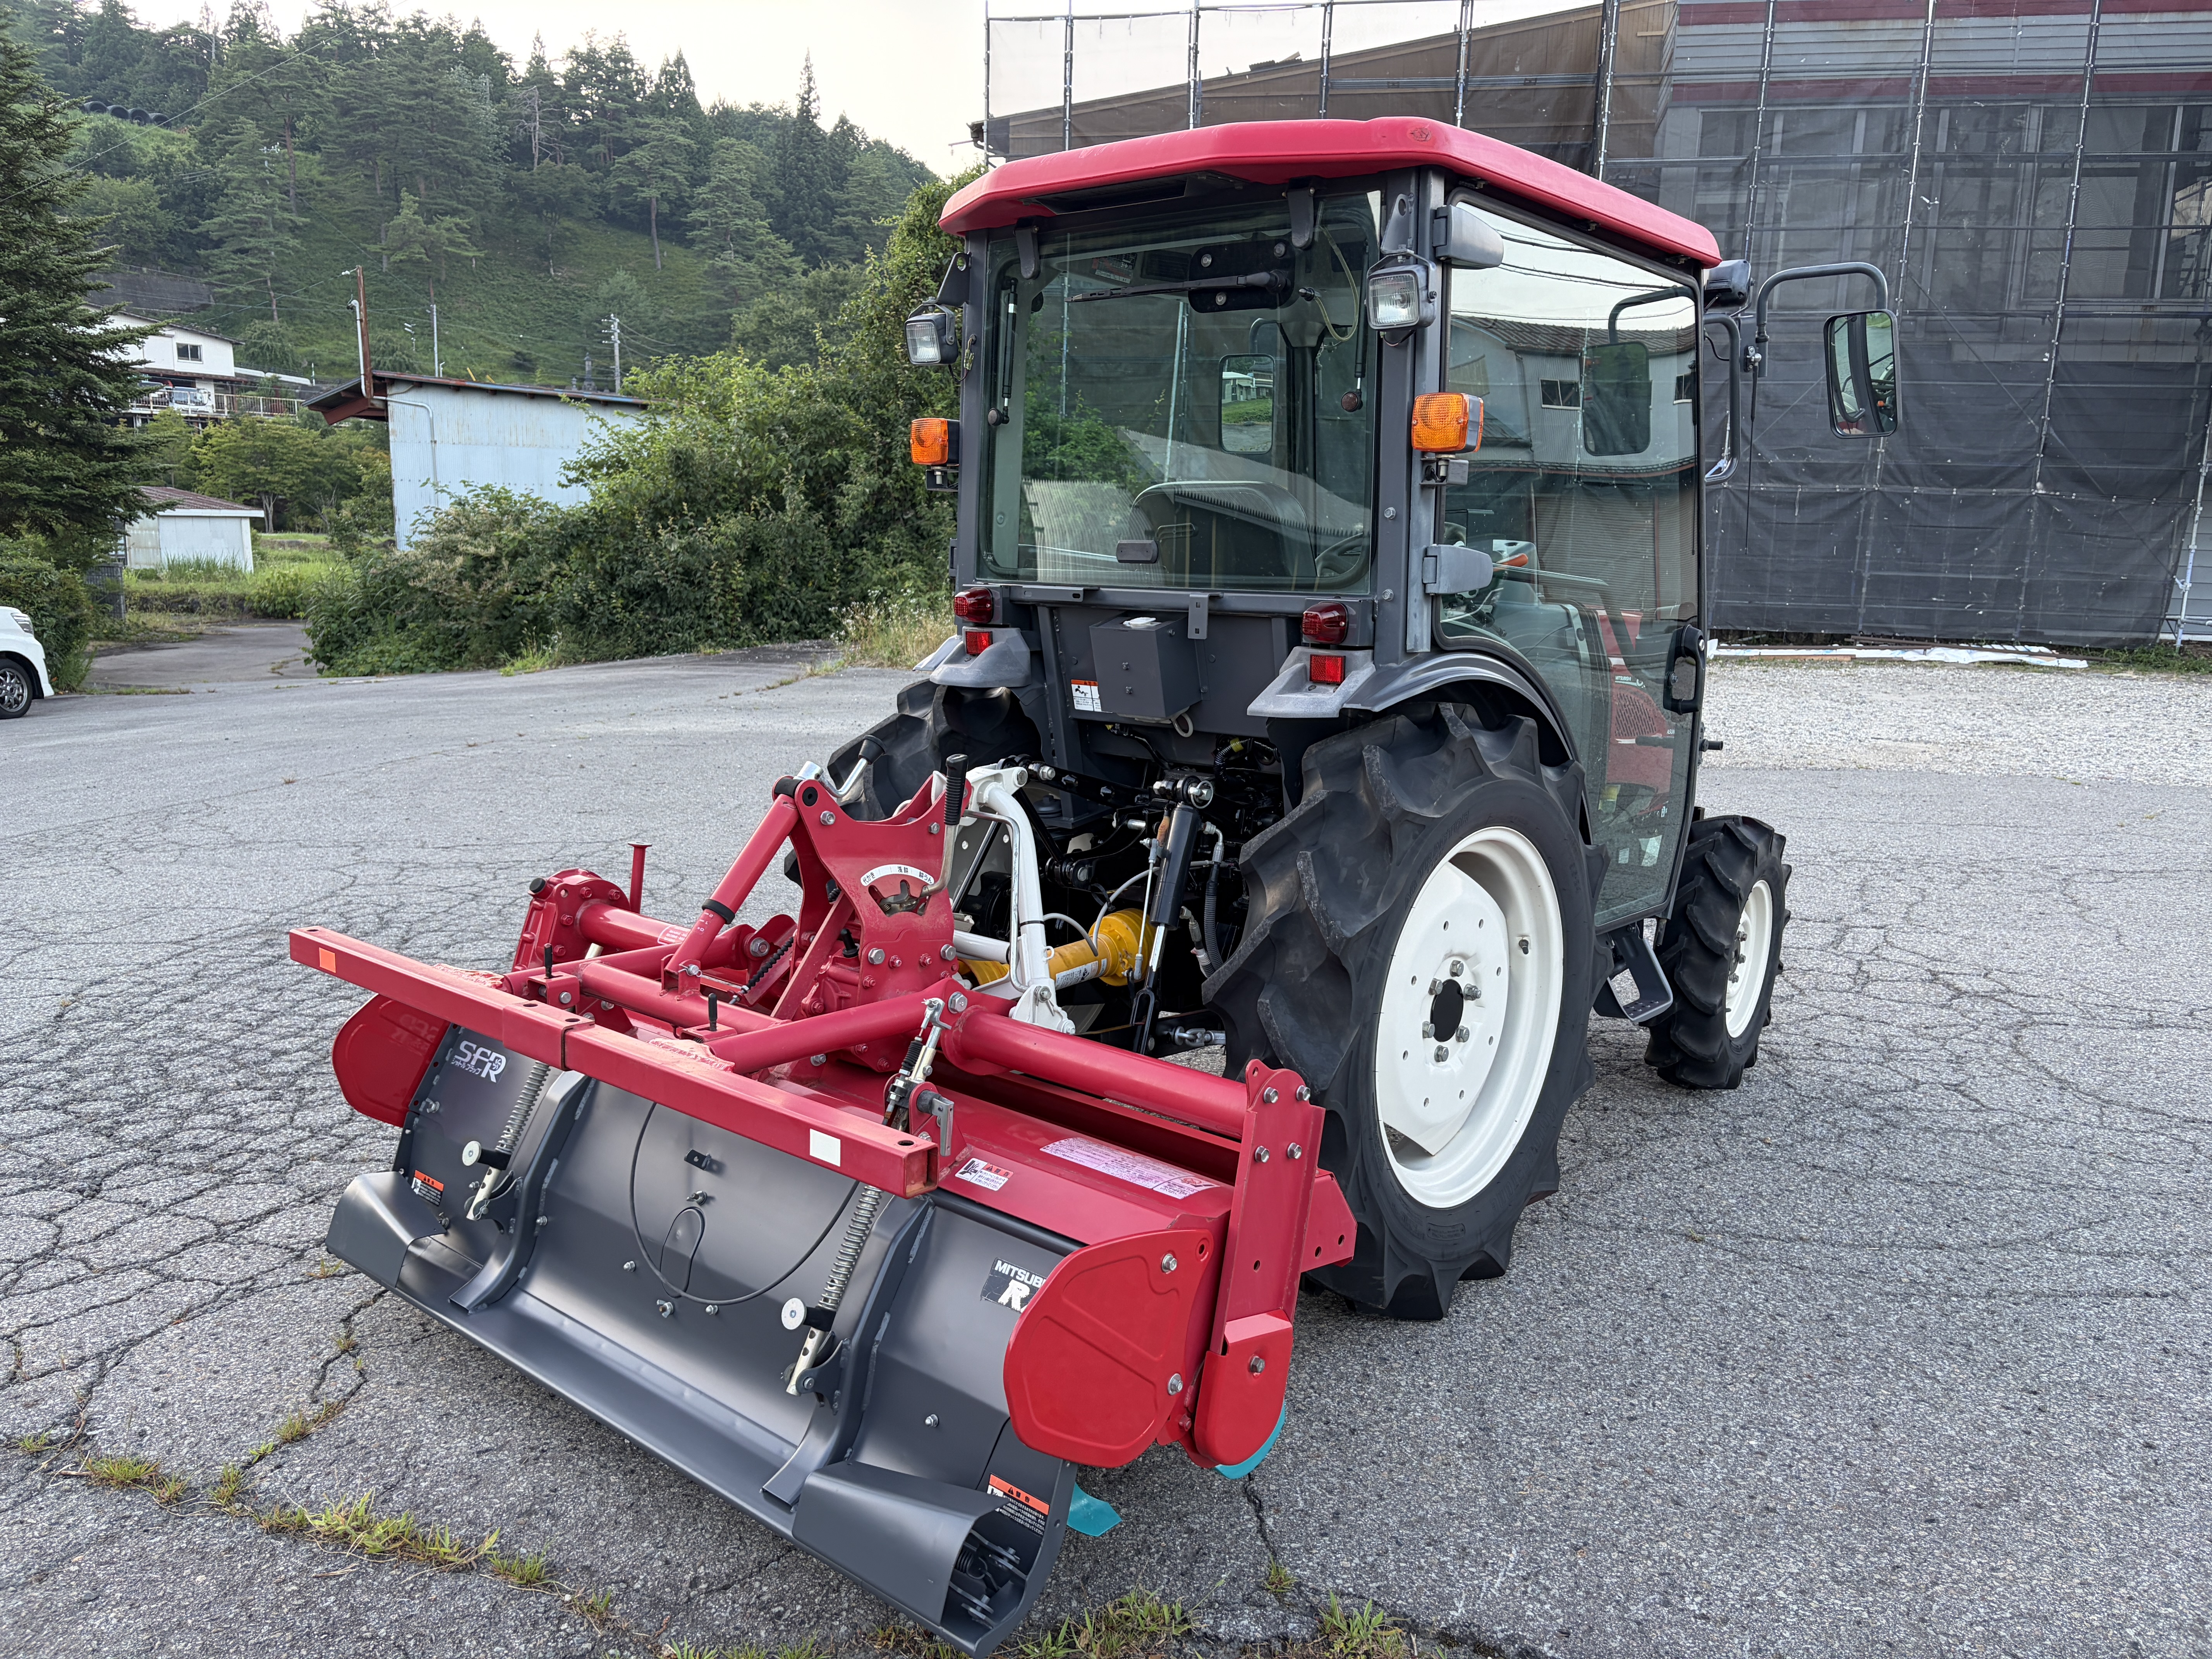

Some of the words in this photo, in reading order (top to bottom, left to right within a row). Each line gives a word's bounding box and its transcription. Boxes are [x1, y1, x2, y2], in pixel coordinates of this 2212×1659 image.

[862, 872, 876, 884] 代かき
[919, 871, 932, 884] 耕うん
[998, 1279, 1030, 1313] R
